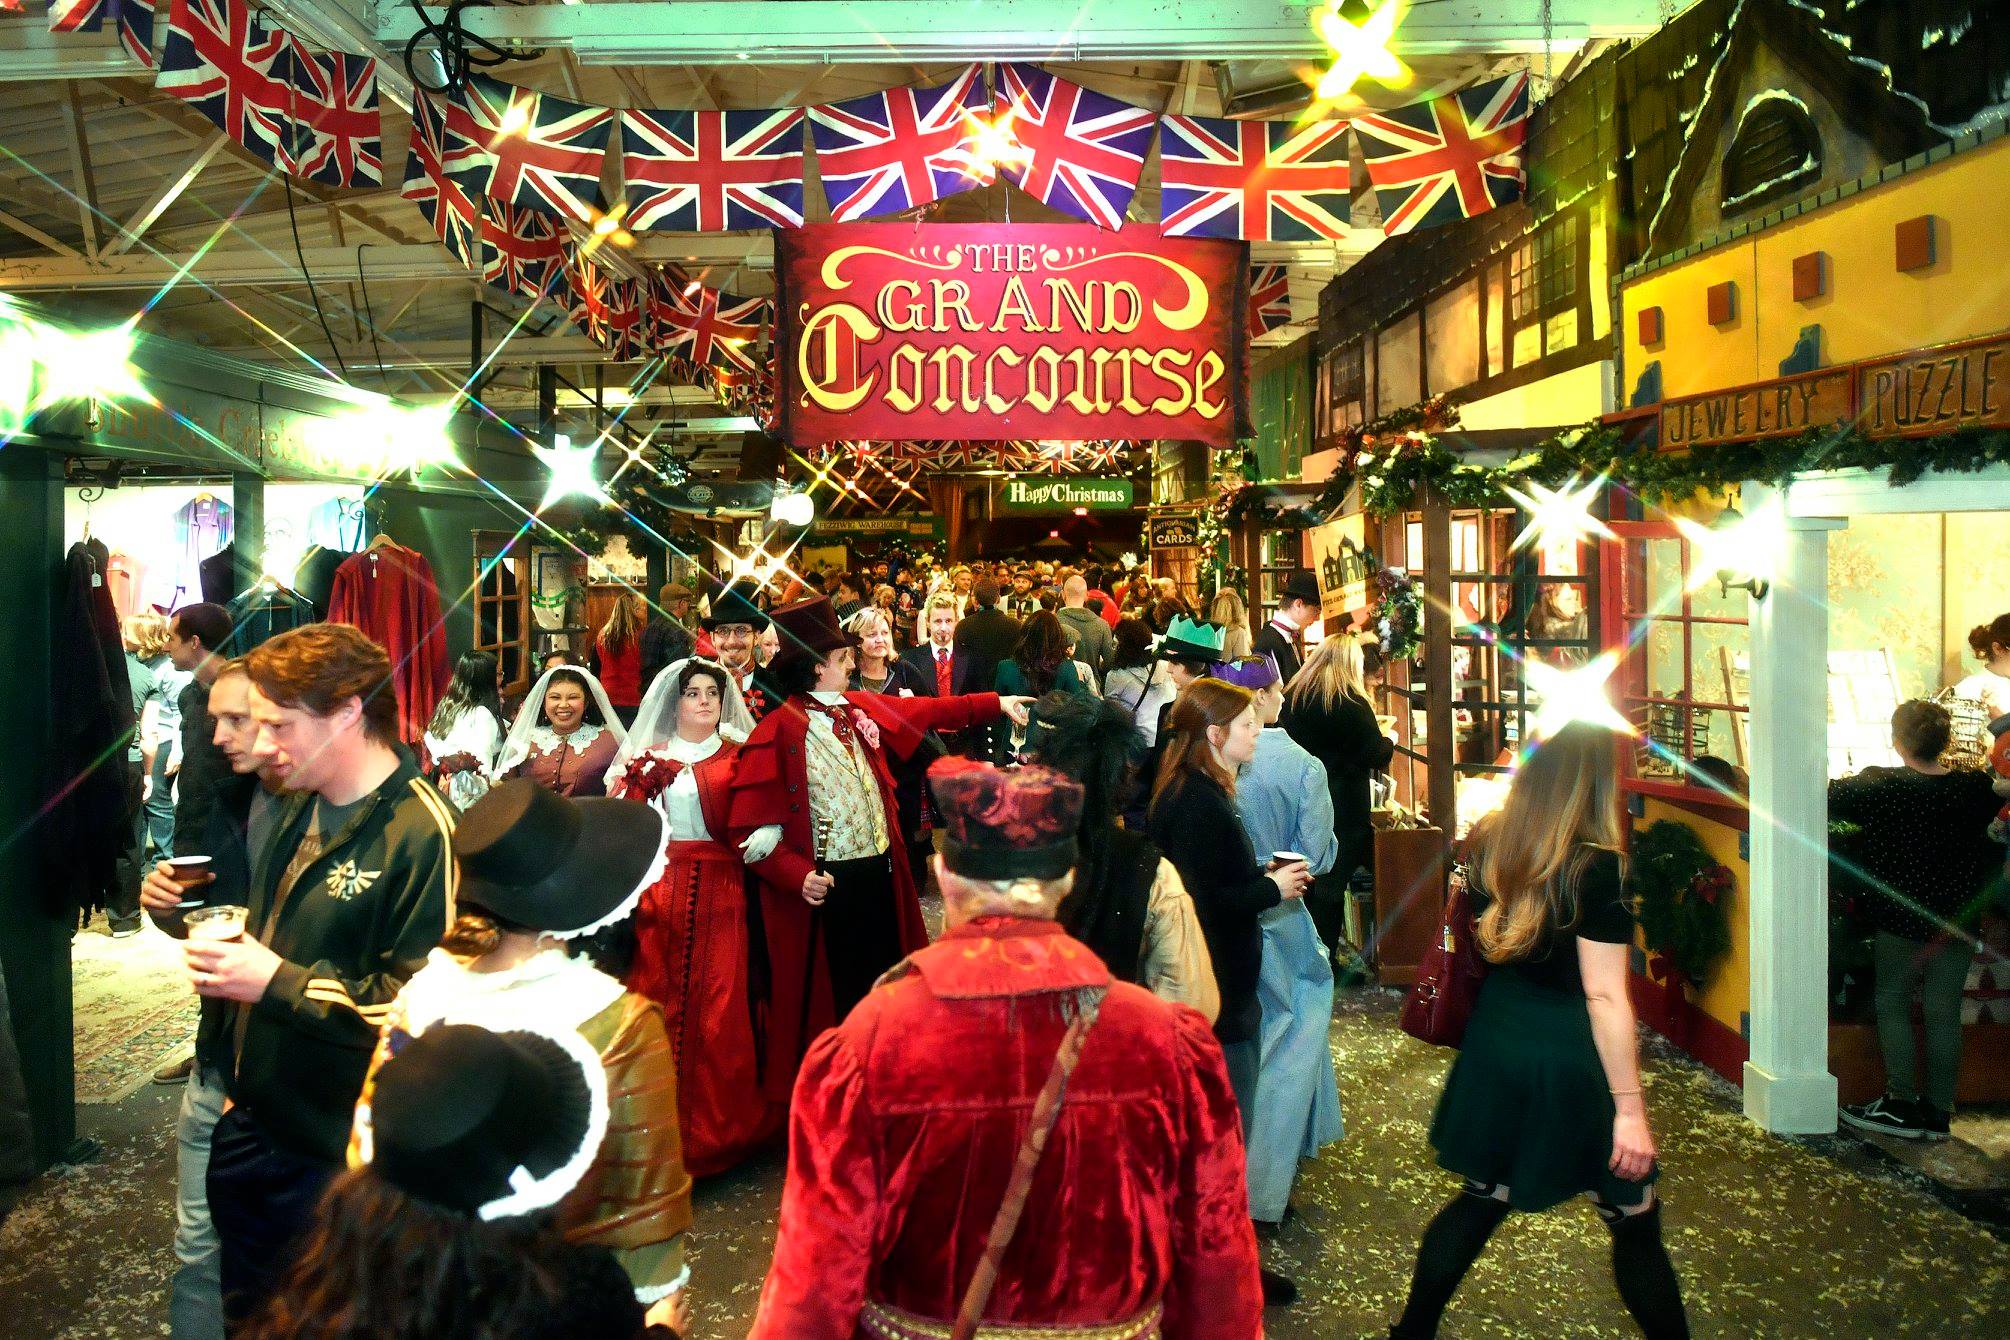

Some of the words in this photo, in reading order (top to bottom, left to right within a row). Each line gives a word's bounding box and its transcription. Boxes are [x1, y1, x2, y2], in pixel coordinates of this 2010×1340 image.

[964, 243, 1038, 273] THE
[876, 275, 1143, 333] GRAND
[798, 301, 1228, 419] Concourse
[1669, 382, 1818, 442] JEWELRY
[1874, 350, 2002, 429] PUZZLE
[1010, 482, 1053, 504] Happy
[1051, 483, 1125, 502] Christmas
[1156, 534, 1193, 545] CARDS
